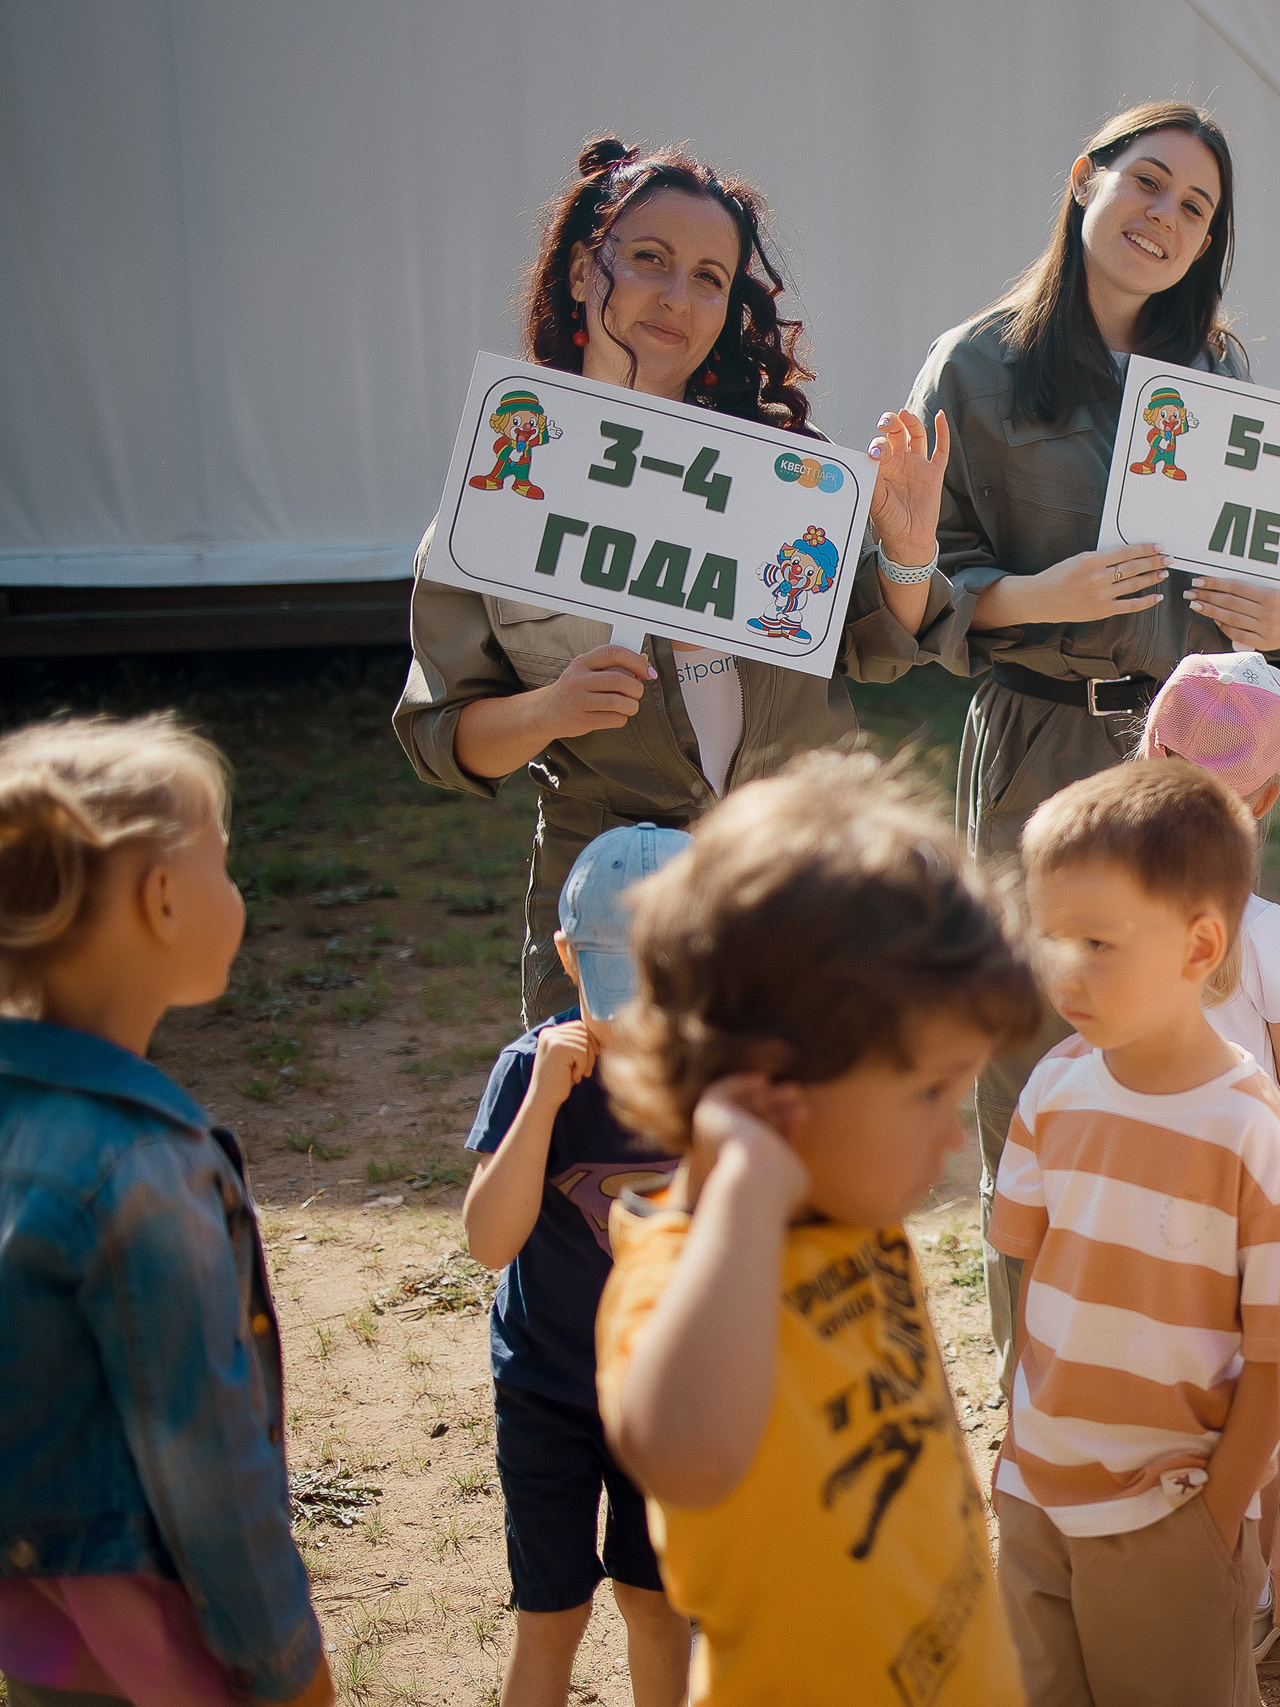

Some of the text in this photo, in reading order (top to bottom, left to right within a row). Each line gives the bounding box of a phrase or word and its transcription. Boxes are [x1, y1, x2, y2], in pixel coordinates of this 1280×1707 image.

[780, 460, 812, 475] КВЕСТ
[813, 469, 839, 483] ПАРК
[535, 512, 737, 620] ГОДА
